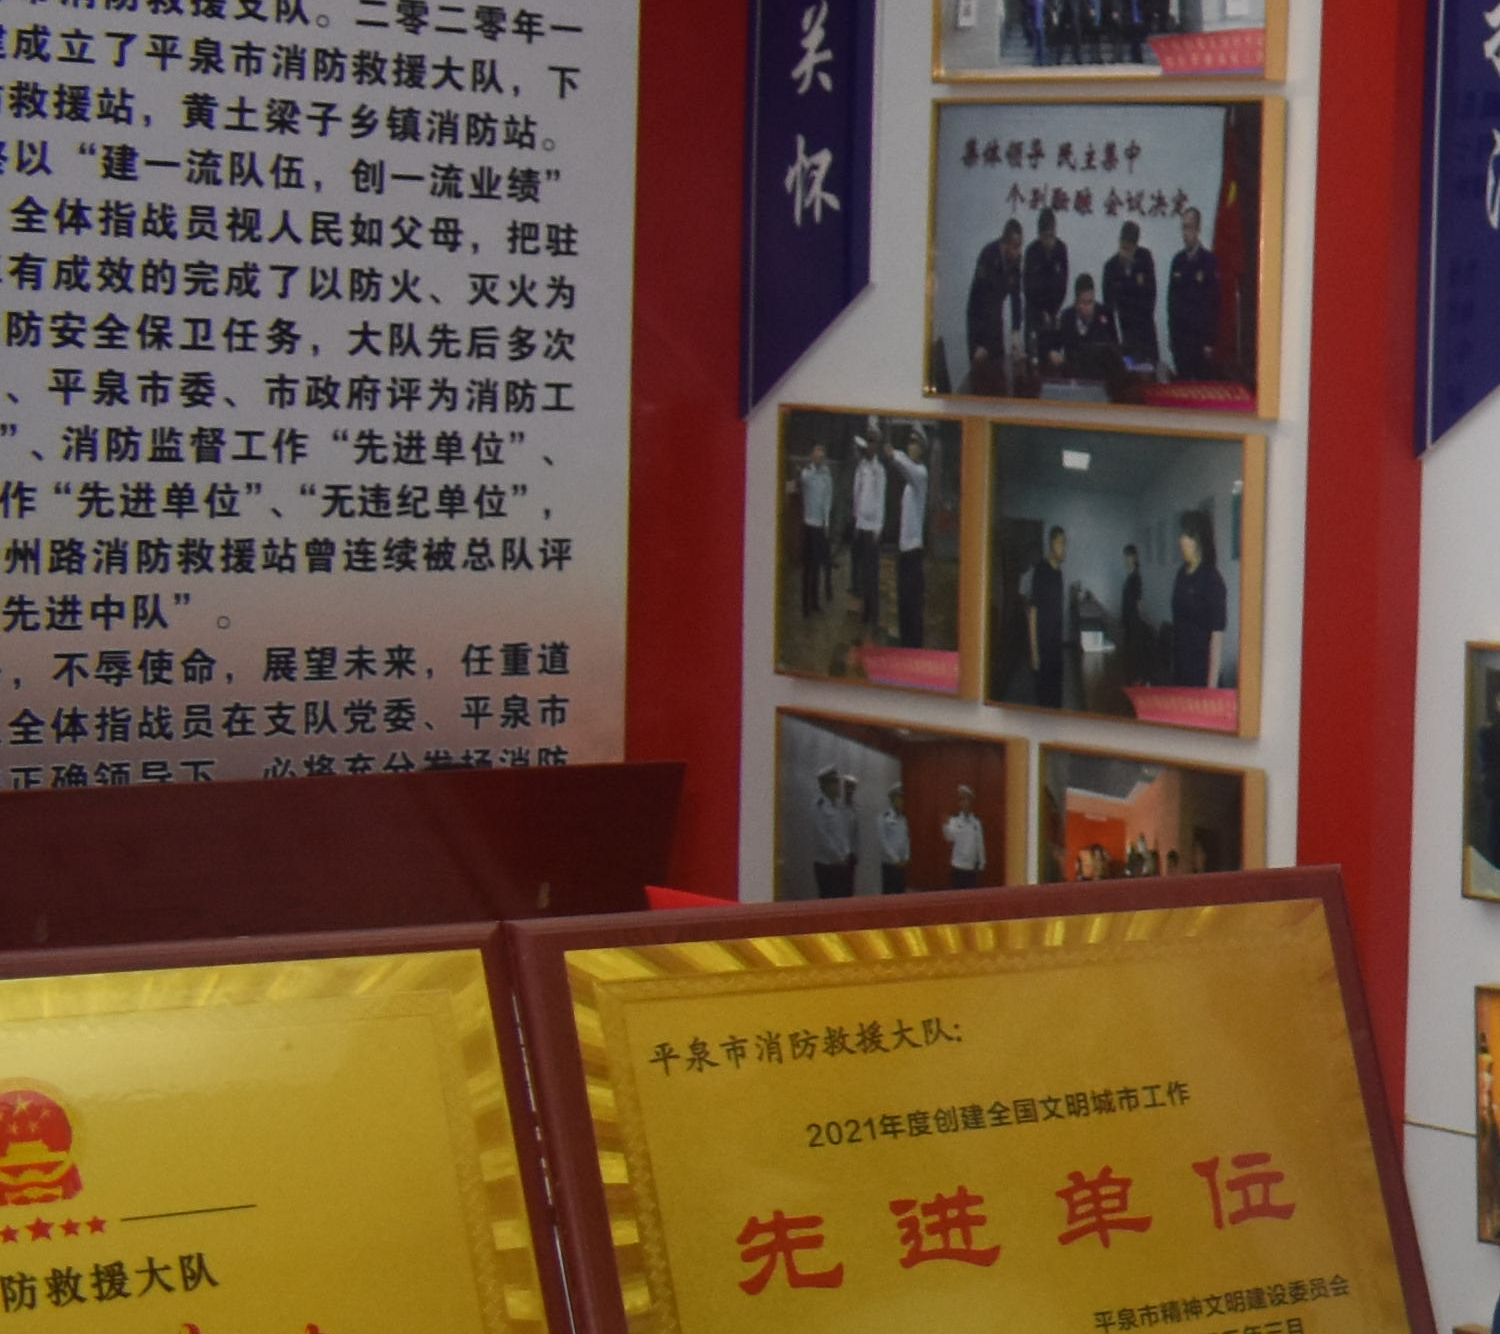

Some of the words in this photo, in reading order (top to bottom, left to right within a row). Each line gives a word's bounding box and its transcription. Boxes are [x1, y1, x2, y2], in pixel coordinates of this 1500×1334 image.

[0, 24, 580, 100] 成立了平泉市消防救援大队，下
[0, 140, 559, 203] 以“建一流队伍，创一流业绩”
[808, 1079, 1190, 1148] 2021年度创建全国文明城市工作
[735, 1151, 1296, 1296] 先进单位
[1094, 1274, 1351, 1334] 平泉市精神文明建设委员会
